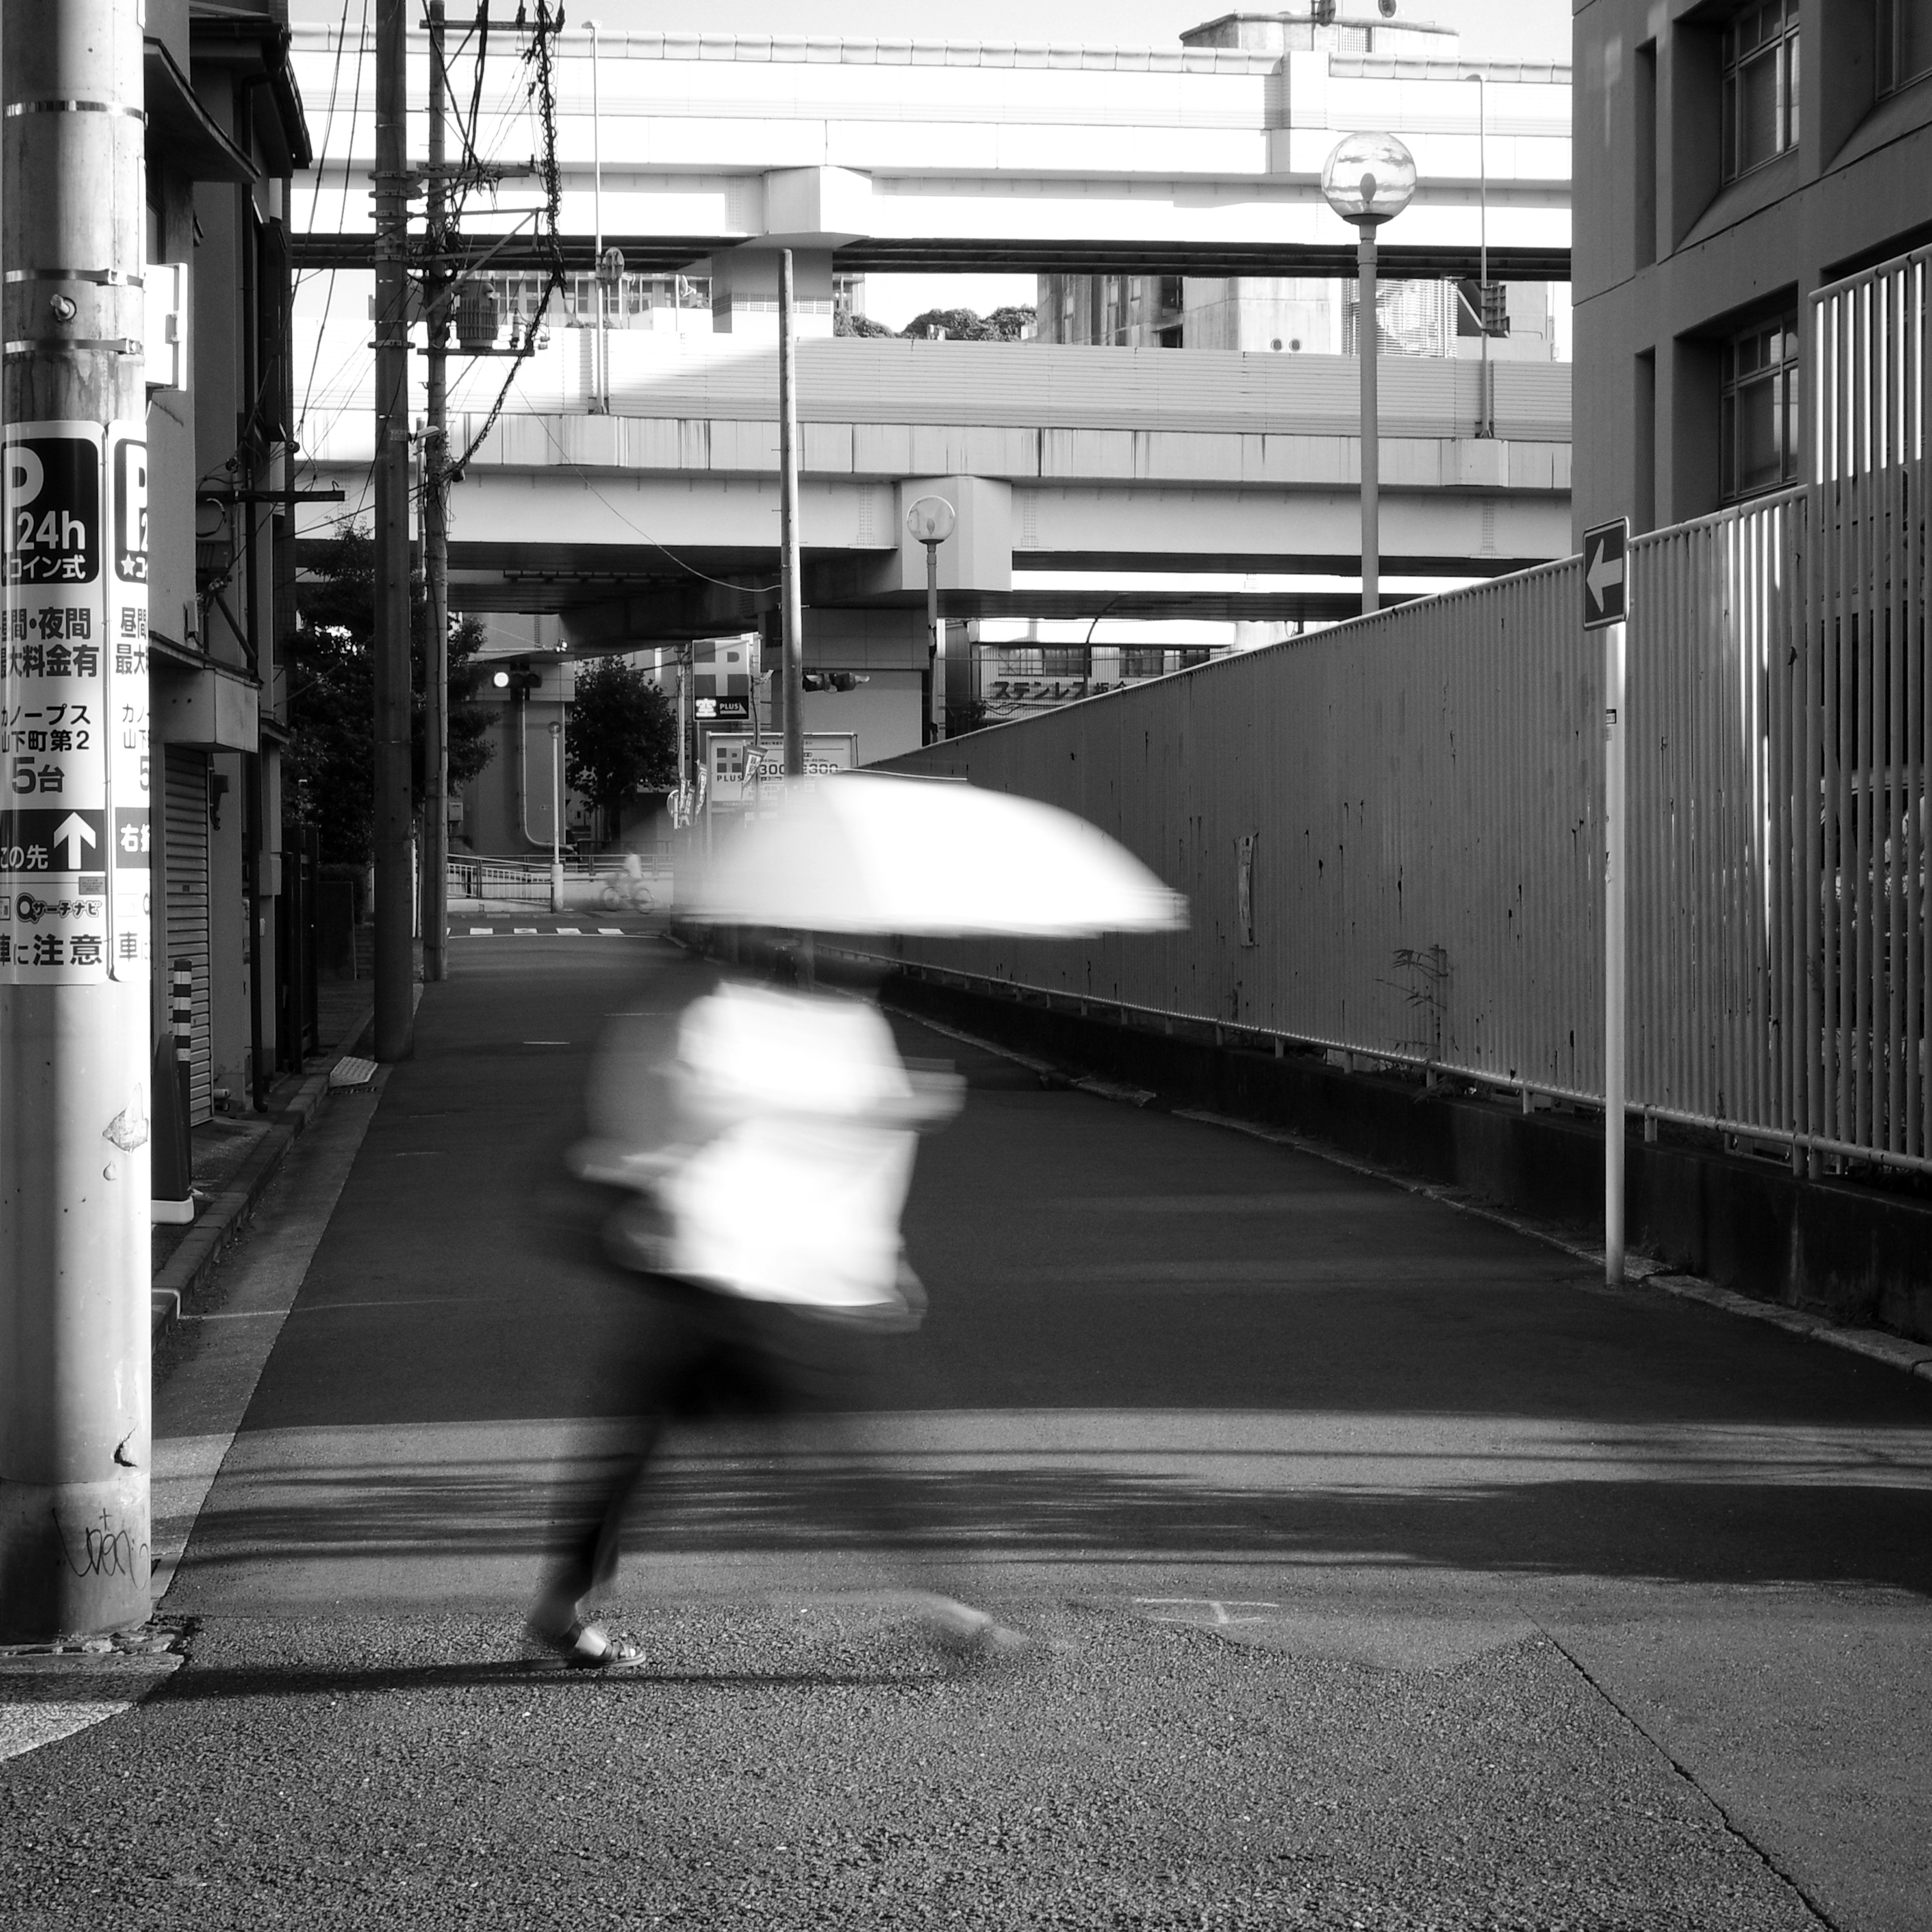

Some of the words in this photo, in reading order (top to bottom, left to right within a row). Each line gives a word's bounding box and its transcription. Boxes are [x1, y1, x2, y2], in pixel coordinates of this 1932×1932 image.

[4, 446, 44, 553] P
[17, 510, 86, 550] 24h
[10, 554, 86, 579] コイン式
[719, 702, 740, 710] PLUS
[2, 730, 90, 753] 山下町第2
[12, 757, 64, 793] 5台
[1, 844, 48, 869] この先
